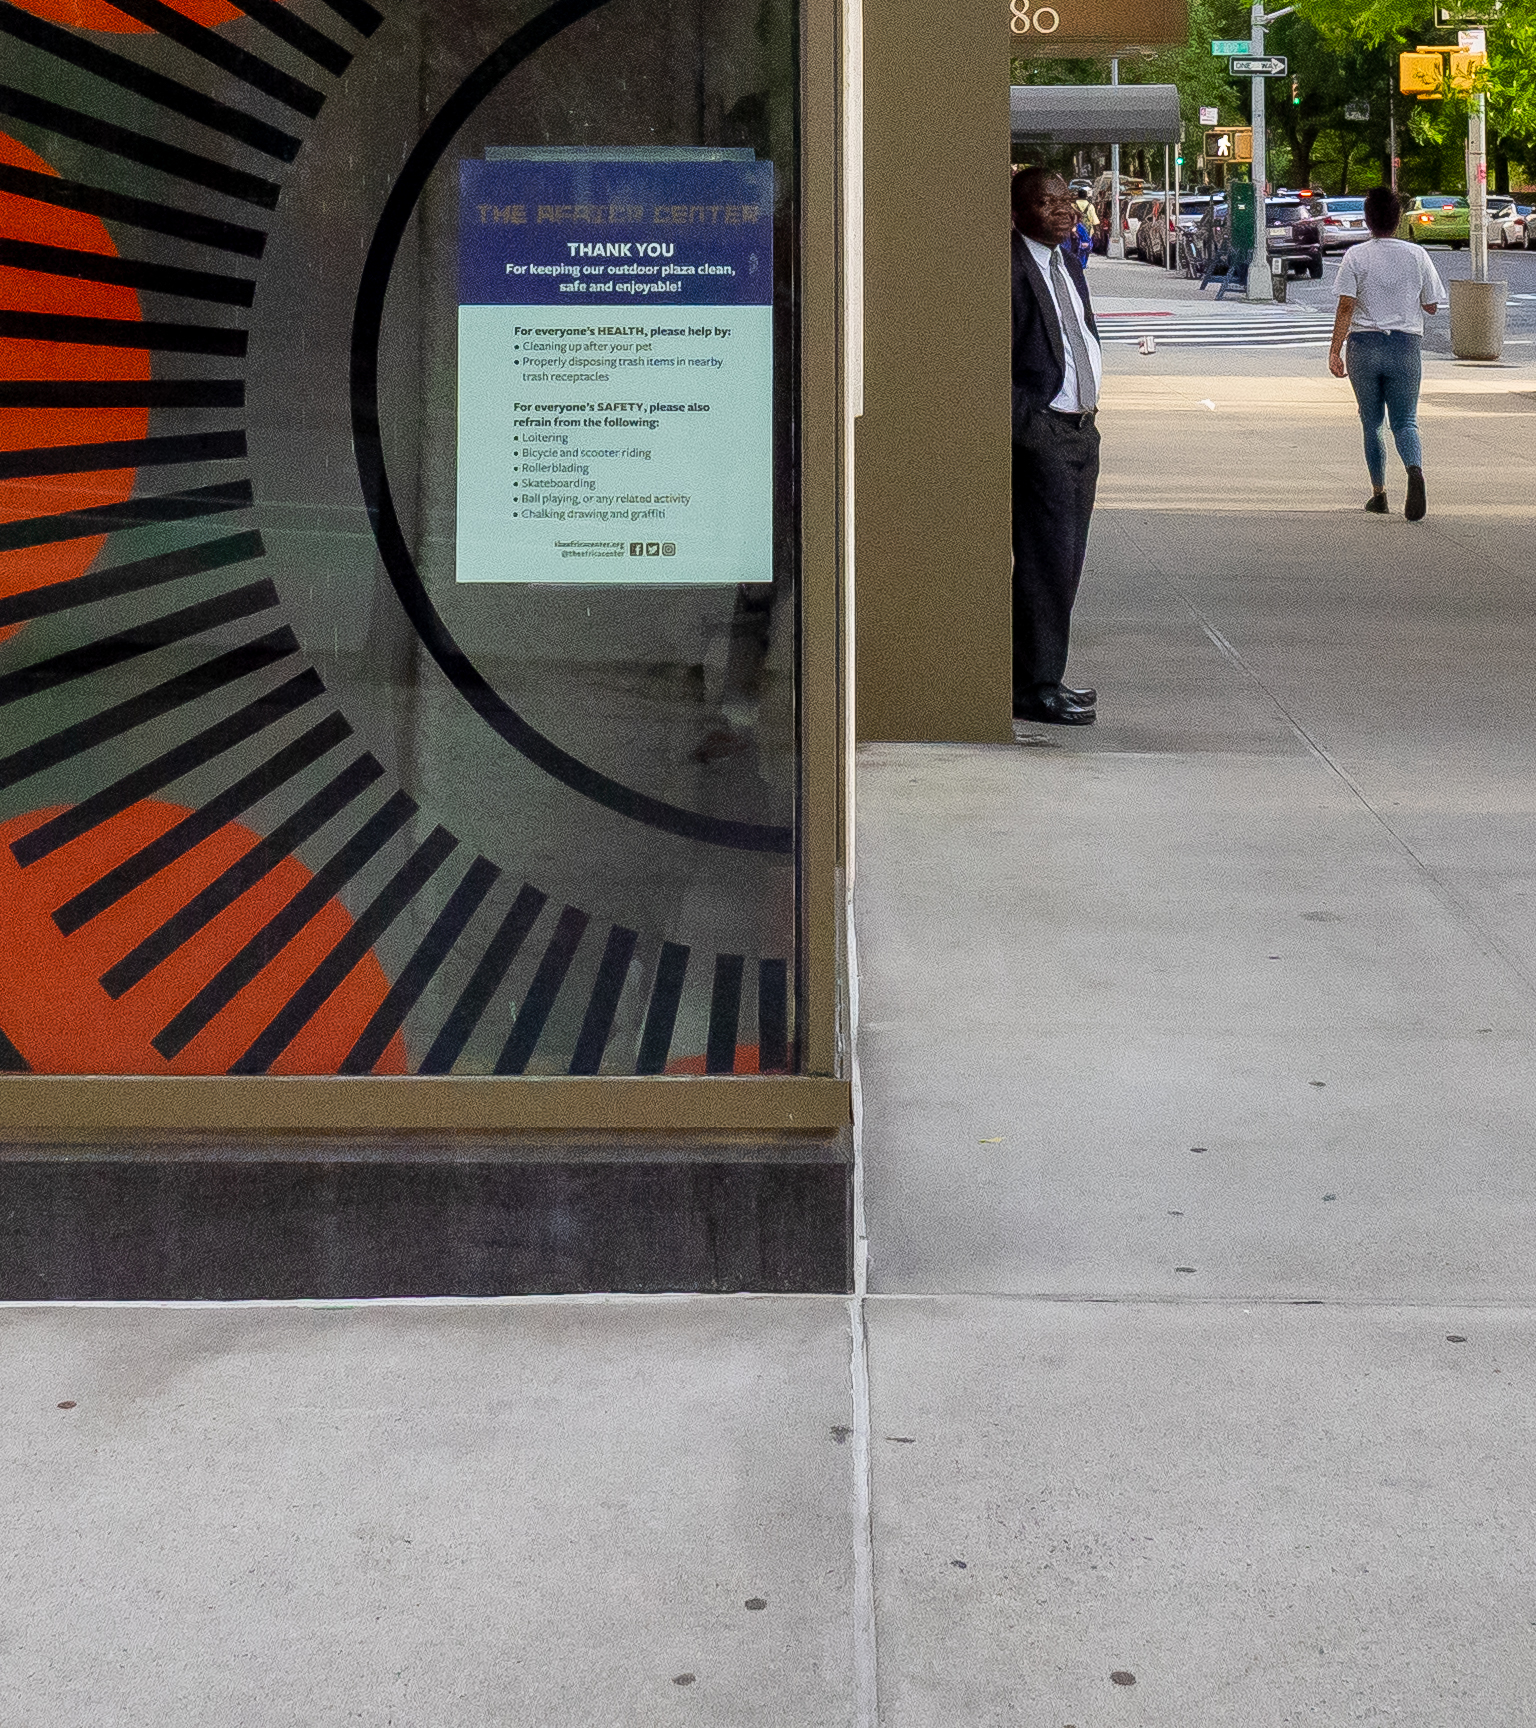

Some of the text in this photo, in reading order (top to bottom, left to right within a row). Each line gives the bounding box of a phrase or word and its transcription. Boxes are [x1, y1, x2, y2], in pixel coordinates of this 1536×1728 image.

[478, 203, 527, 224] THE
[653, 203, 760, 224] CENTER
[567, 242, 675, 258] THANK YOU
[505, 263, 736, 278] For keeping our outdoor plaza clean,
[559, 281, 682, 295] safe and enjoyable!
[514, 326, 732, 339] For everyone's HEALTH, please help by:
[522, 342, 652, 355] Cleaning up after your pet
[522, 357, 724, 369] Properly disposing trash items in nearby
[522, 372, 610, 384] trash receptacles
[514, 402, 711, 414] For everyone's SAFETY, please also
[514, 418, 660, 430] refrain from the following:
[522, 433, 569, 445] Loitering
[522, 448, 652, 460] Bicycle and scooter riding
[521, 463, 590, 475] Rollerblading
[521, 478, 596, 491] Skateboarding
[521, 494, 692, 506] Ball playing, or any related activity
[521, 509, 666, 521] Chalking drawing and graffiti
